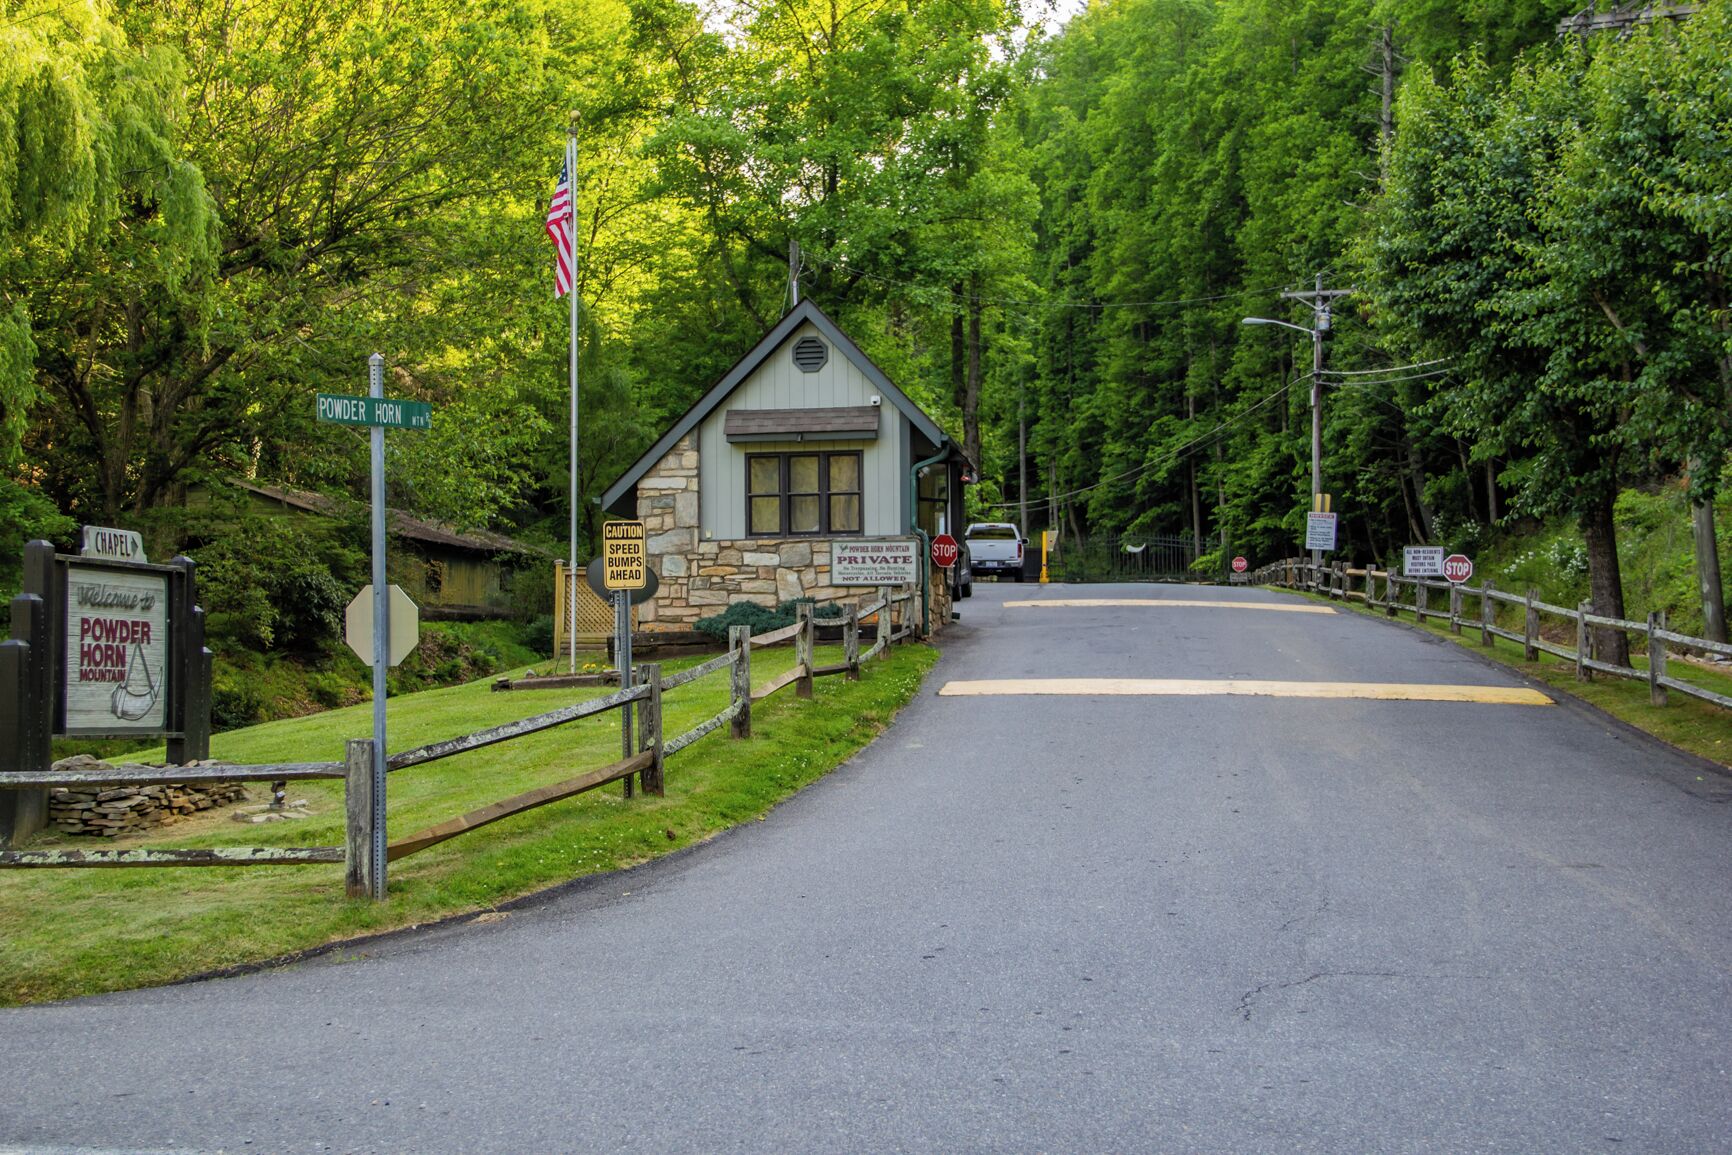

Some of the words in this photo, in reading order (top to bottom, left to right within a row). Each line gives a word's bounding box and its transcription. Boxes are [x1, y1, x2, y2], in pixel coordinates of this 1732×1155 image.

[319, 398, 366, 421] POWDER
[375, 402, 402, 425] HORN
[605, 525, 643, 538] CAUTION
[95, 531, 131, 557] CHAPEL
[609, 543, 640, 554] SPEED
[849, 545, 869, 553] POWDER
[870, 545, 884, 553] HORN
[885, 544, 910, 552] MOUNTAIN
[933, 543, 957, 557] STOP
[608, 557, 642, 567] BUMPS
[837, 555, 912, 565] PRIVATE
[609, 569, 641, 580] AHEAD
[1445, 562, 1469, 576] STOP
[77, 584, 140, 610] Welcome
[140, 592, 156, 610] to
[80, 617, 151, 645] POWDER
[80, 643, 127, 668] HORN
[79, 668, 126, 682] MOUNTAIN
